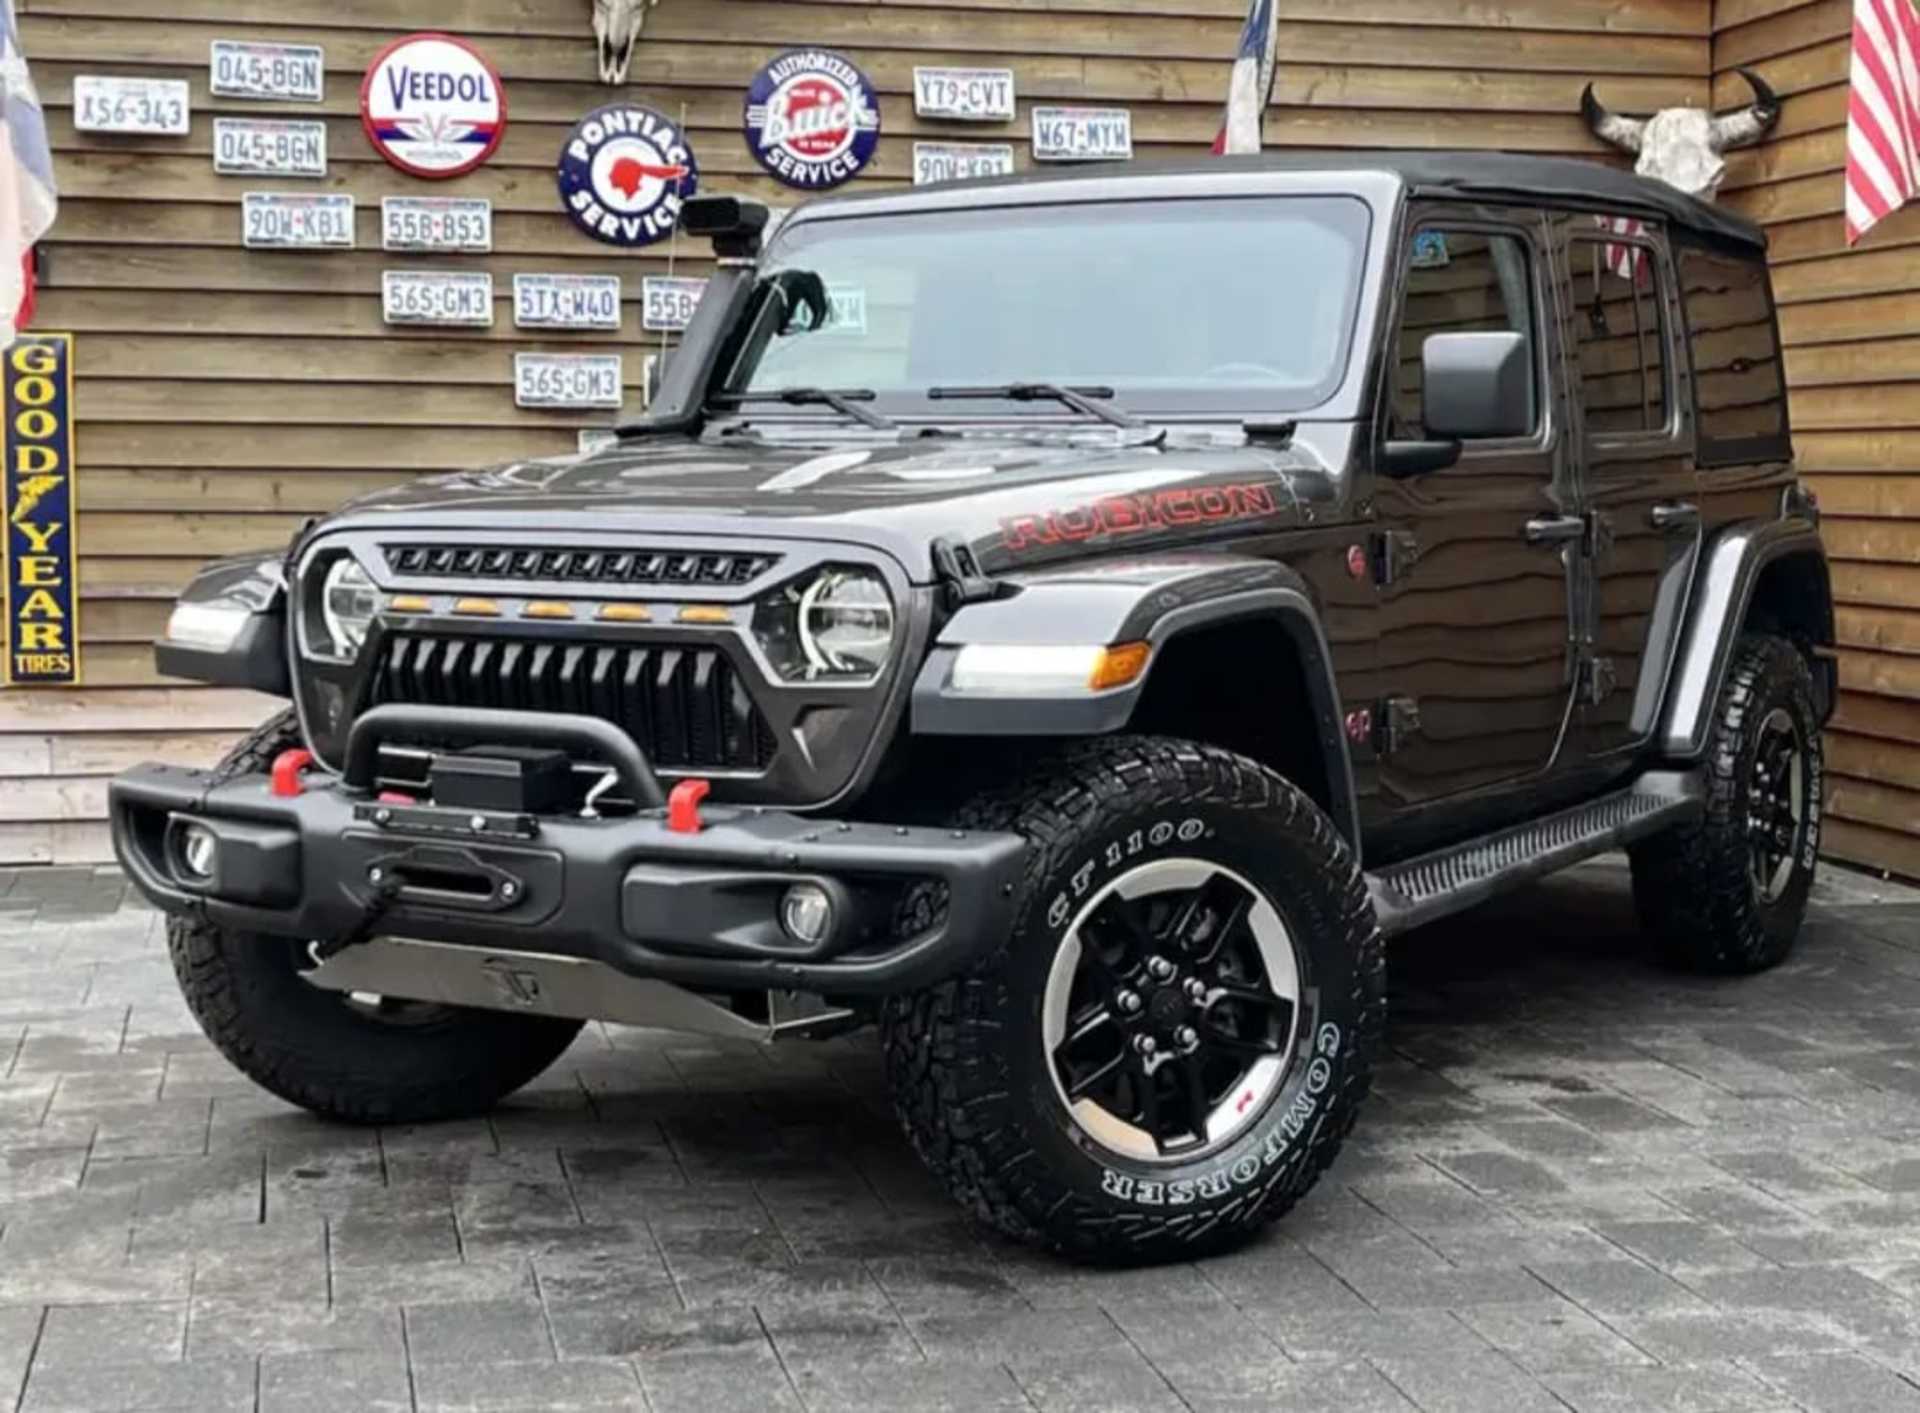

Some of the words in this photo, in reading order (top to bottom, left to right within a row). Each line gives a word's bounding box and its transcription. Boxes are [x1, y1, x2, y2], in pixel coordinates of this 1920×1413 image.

[387, 66, 491, 111] VEEDOL
[767, 52, 859, 87] AUTHORIZED
[568, 109, 688, 166] PONTIAC
[765, 148, 859, 183] SERVICE
[1000, 482, 1276, 550] RUBICON
[15, 654, 71, 674] TIRES
[1101, 1021, 1341, 1205] COMFORSER
